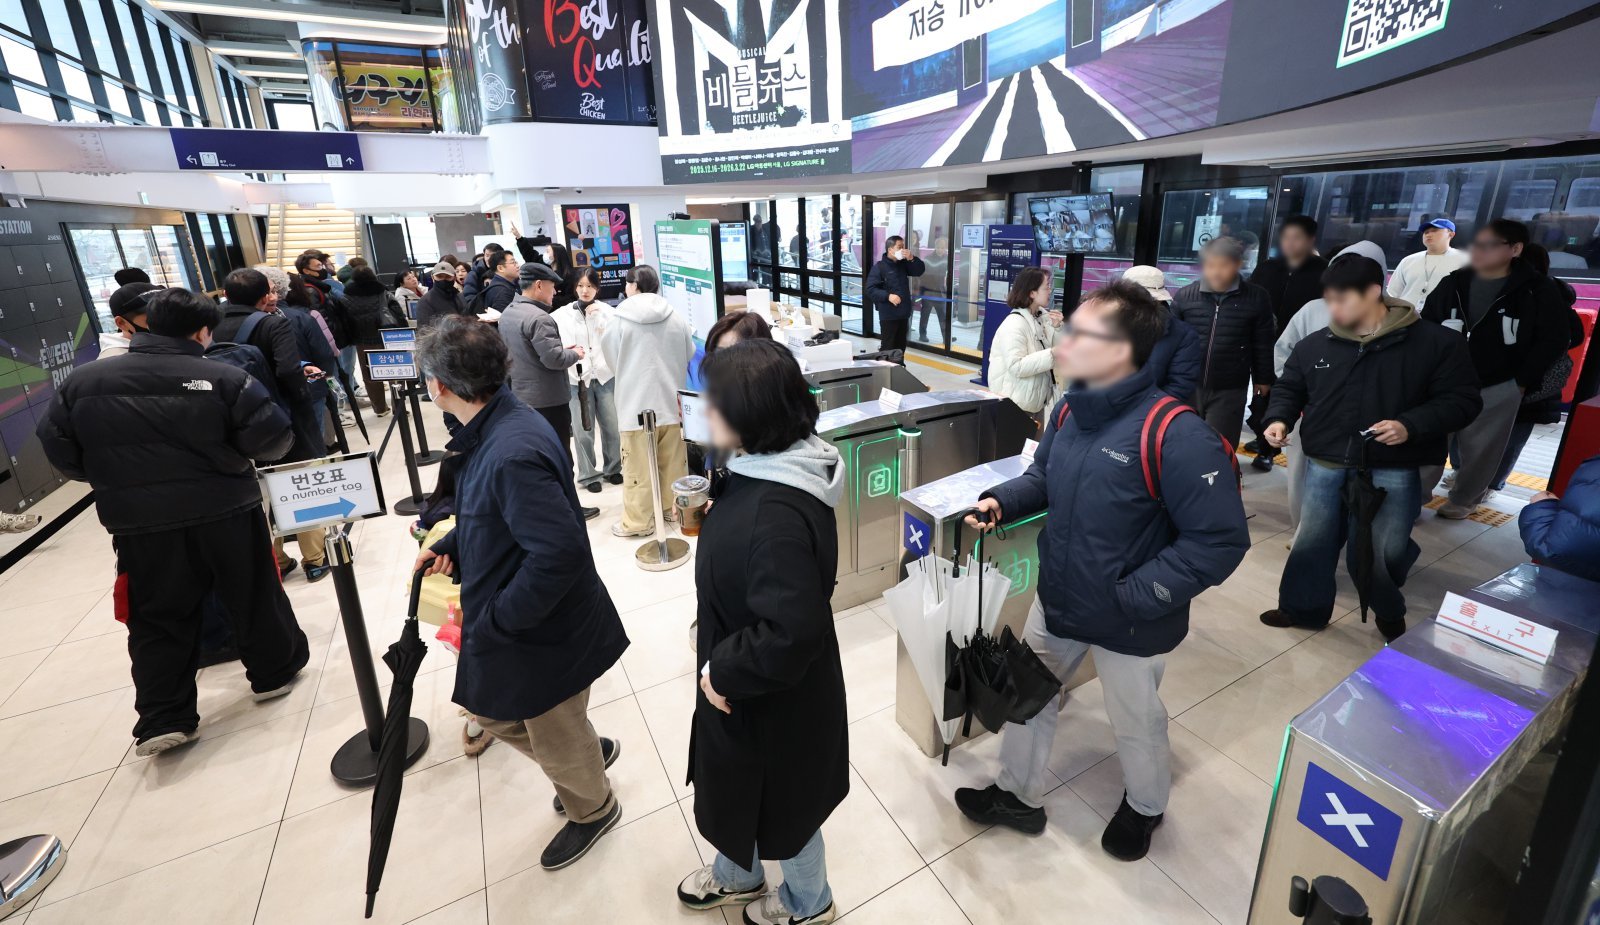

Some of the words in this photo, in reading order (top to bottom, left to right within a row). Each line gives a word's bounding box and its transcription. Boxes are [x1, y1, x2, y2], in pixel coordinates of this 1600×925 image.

[543, 0, 618, 48] Best
[909, 0, 945, 40] 저승
[478, 31, 492, 68] of
[705, 62, 808, 109] 비틀쥬스
[579, 104, 606, 120] CHICKEN
[581, 92, 606, 111] Best
[291, 467, 347, 491] 번호표
[292, 486, 338, 501] number
[341, 482, 363, 491] tag
[1470, 620, 1514, 641] EXIT
